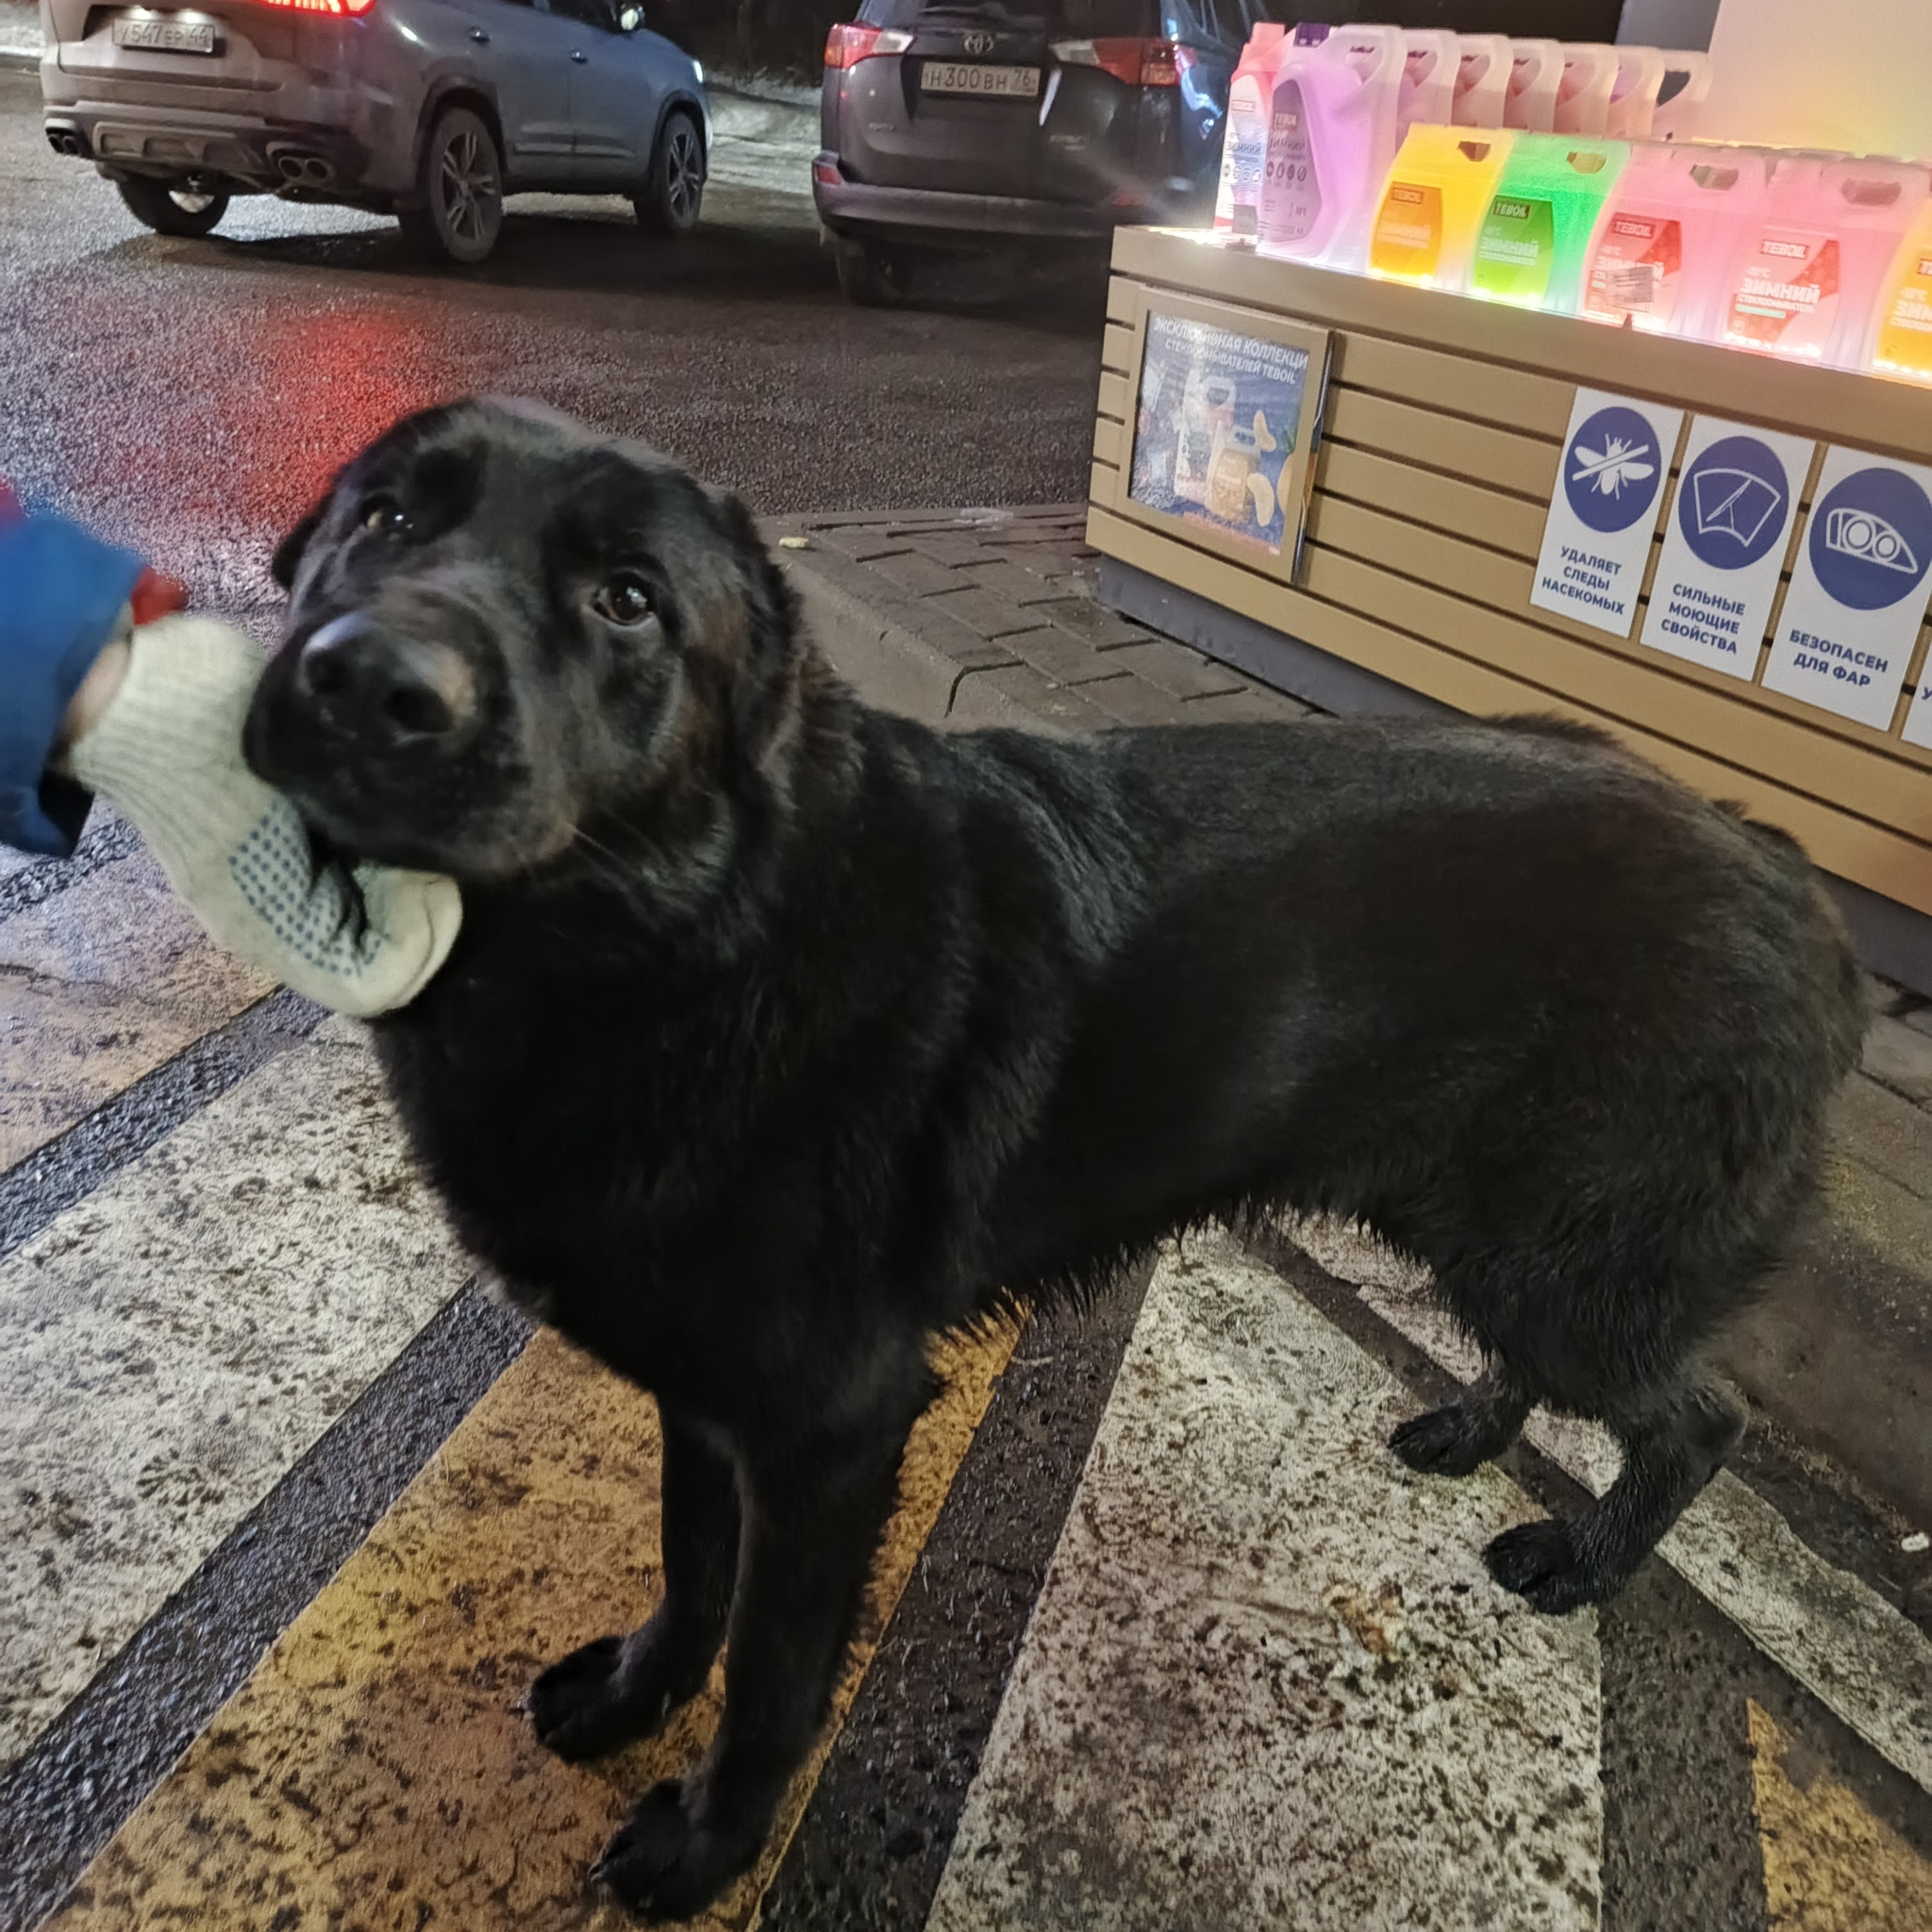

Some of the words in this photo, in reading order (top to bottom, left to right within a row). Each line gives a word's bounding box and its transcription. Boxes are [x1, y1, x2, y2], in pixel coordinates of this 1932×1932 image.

[1495, 203, 1526, 218] TEBOIL
[1762, 241, 1806, 258] TEBOIL
[1740, 277, 1821, 303] ЗИМНИЙ
[1263, 366, 1296, 385] TEBOIL
[1560, 545, 1622, 575] УДАЛЯЕТ
[1563, 566, 1610, 591] СЛЕДЫ
[1541, 576, 1624, 615] НАСЕКОМЫХ
[1673, 583, 1746, 616] СИЛЬНЫЕ
[1668, 602, 1740, 635] МОЮЩИЕ
[1661, 619, 1738, 655] СВОЙСТВА
[1789, 629, 1889, 673] БЕЗОПАСЕН
[1793, 653, 1829, 675] ДЛЯ
[1832, 665, 1871, 687] ФАР
